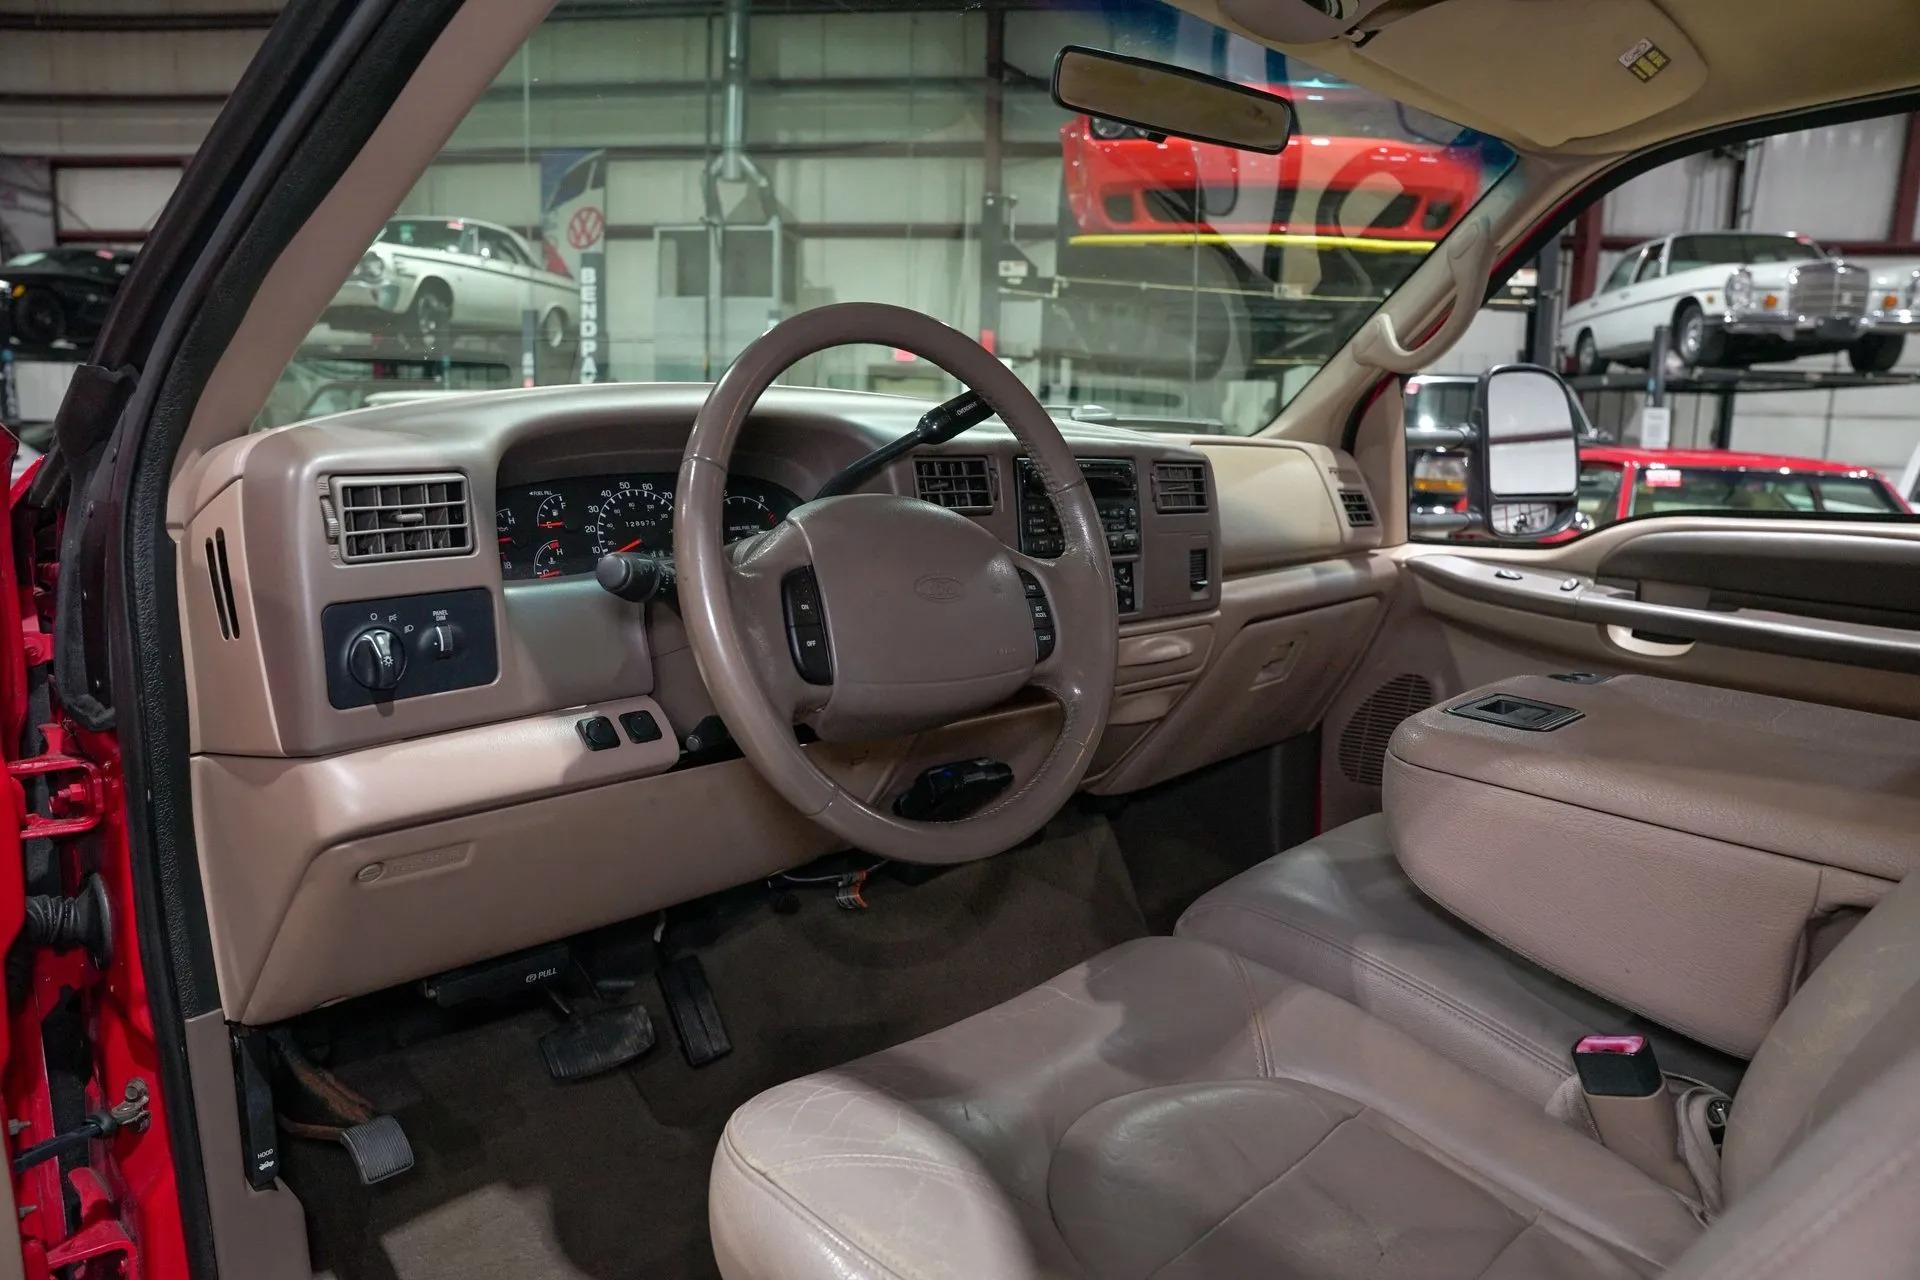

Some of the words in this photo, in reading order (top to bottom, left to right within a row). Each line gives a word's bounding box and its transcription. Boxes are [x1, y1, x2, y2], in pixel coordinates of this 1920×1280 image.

[619, 481, 631, 490] 50
[642, 482, 653, 491] 60
[600, 489, 612, 498] 40
[663, 491, 673, 500] 70
[759, 495, 765, 503] 3
[560, 502, 566, 510] F
[587, 505, 600, 514] 30
[507, 516, 516, 525] H
[584, 525, 596, 533] 20
[556, 548, 564, 556] H
[591, 546, 601, 554] 10
[432, 609, 448, 617] PANEL
[538, 967, 558, 979] PULL
[257, 1148, 274, 1159] HOOD
